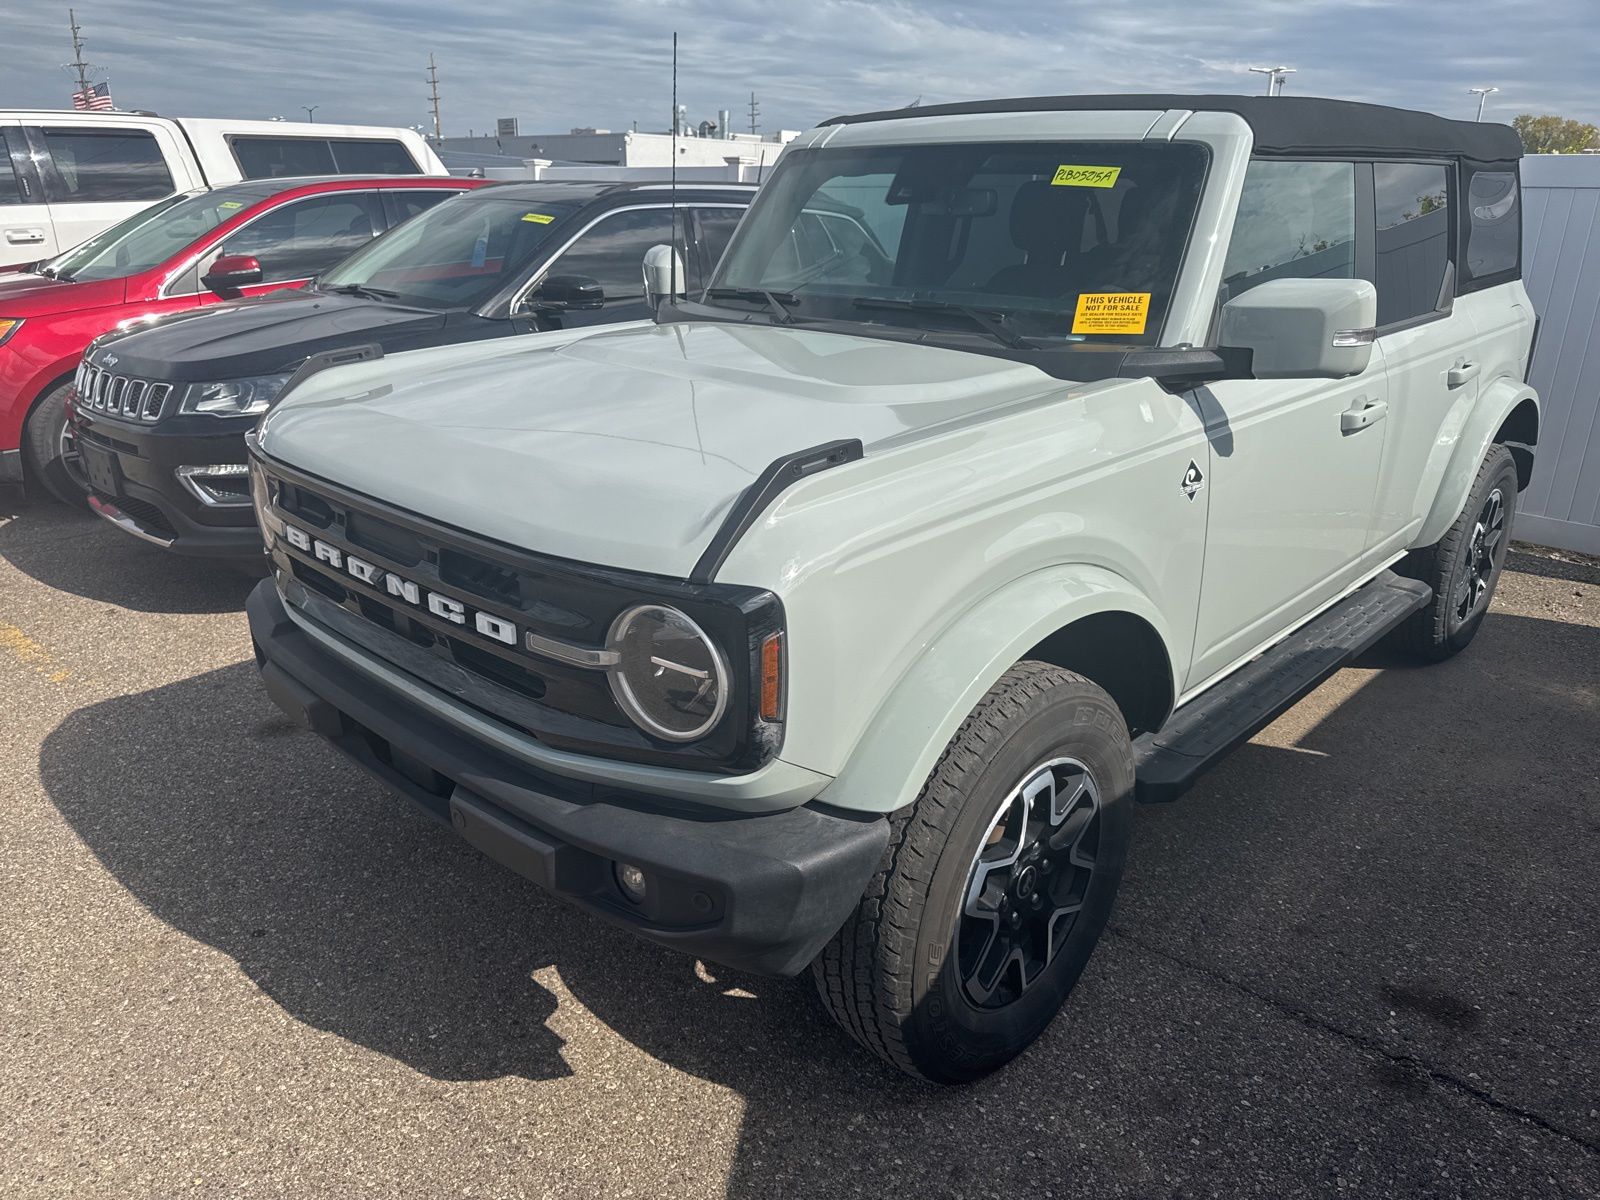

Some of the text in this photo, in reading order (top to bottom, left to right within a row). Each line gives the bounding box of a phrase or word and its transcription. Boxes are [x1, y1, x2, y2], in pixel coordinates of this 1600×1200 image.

[1086, 296, 1144, 304] THIS VEHICLE
[286, 525, 518, 646] BRONCO
